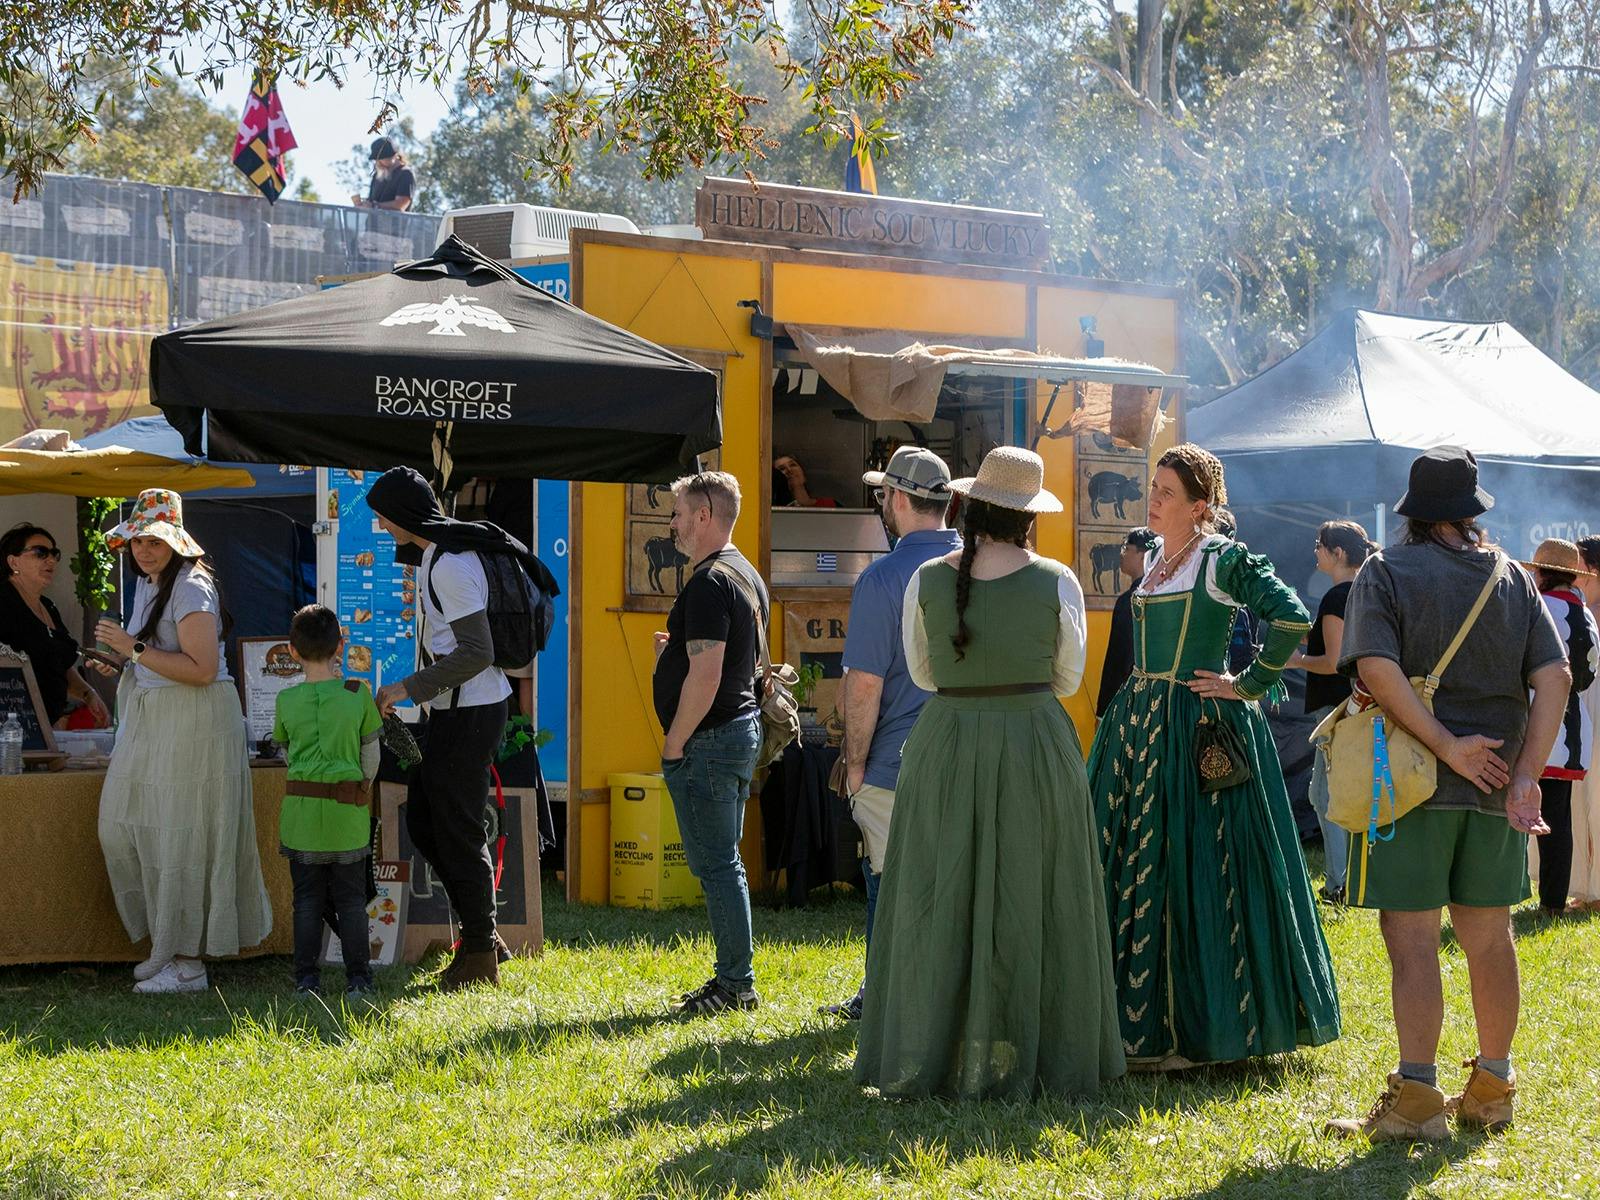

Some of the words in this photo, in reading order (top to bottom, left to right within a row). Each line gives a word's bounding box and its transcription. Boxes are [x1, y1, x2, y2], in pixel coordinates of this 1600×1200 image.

[710, 192, 864, 240] HELLENIC
[871, 209, 1040, 257] SOUVLUCKY
[537, 278, 567, 299] ER
[375, 375, 517, 402] BANCROFT
[376, 396, 512, 420] ROASTERS
[381, 653, 399, 673] FETA
[614, 841, 638, 850] MIXED
[614, 850, 654, 861] RECYCLING
